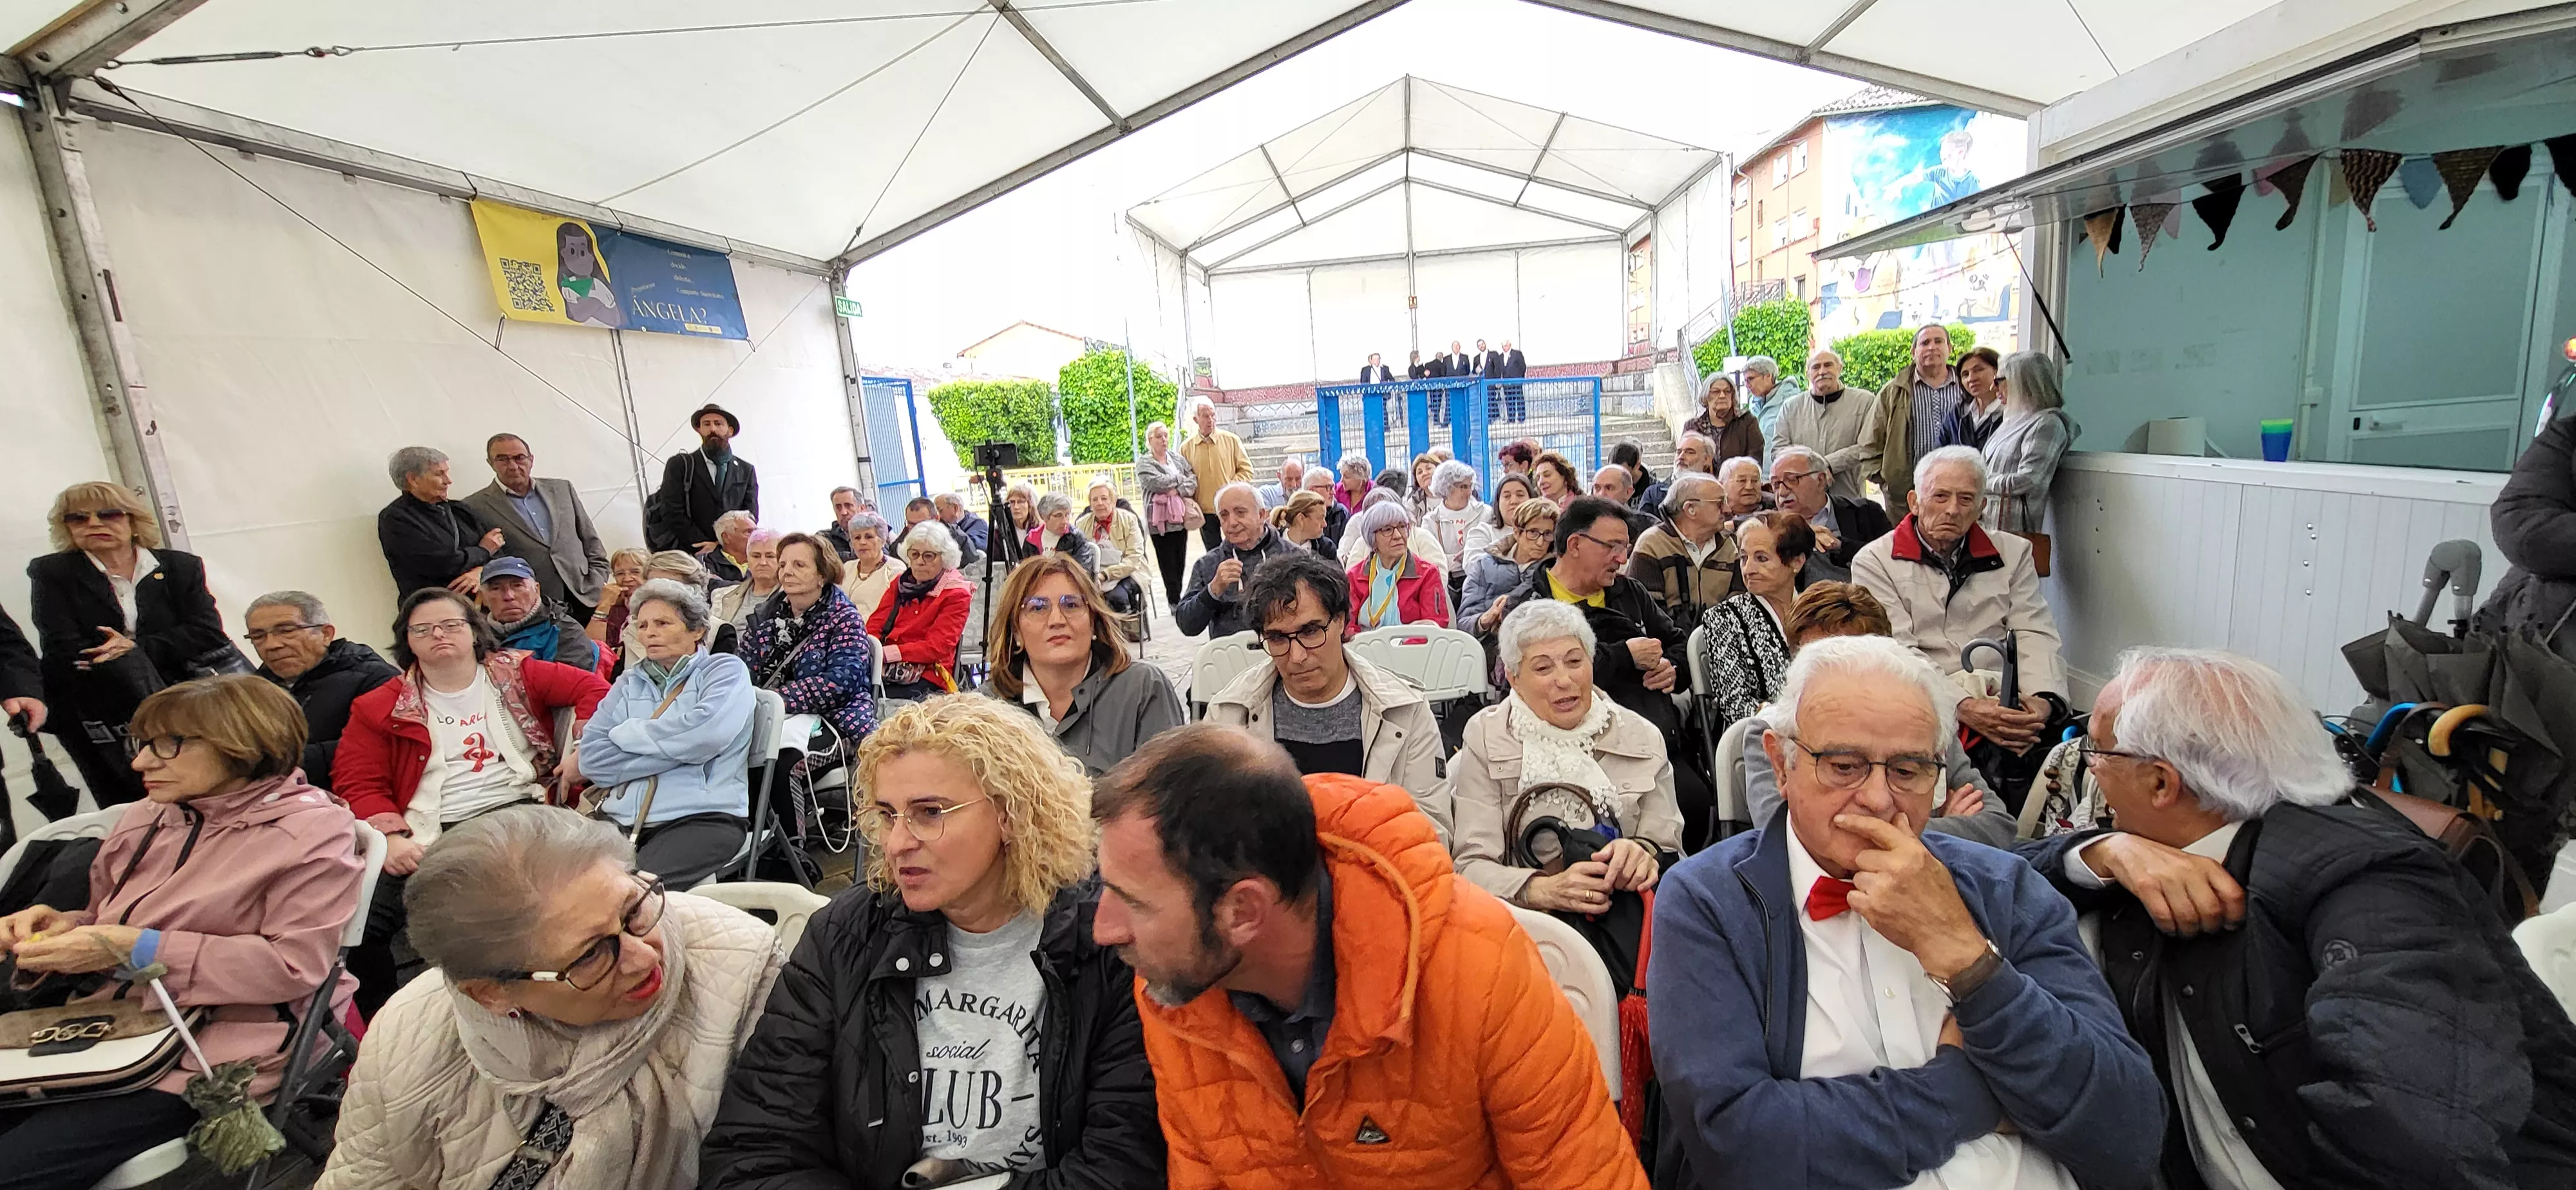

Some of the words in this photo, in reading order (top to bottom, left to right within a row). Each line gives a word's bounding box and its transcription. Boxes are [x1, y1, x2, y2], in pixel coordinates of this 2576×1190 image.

[632, 295, 706, 325] ÁNGELA?
[837, 299, 861, 316] SALIDA
[914, 988, 1041, 1074] MARGARITA
[926, 1039, 991, 1060] social
[922, 1068, 1002, 1129] LUB
[925, 1134, 942, 1143] st.
[947, 1129, 967, 1149] 1993
